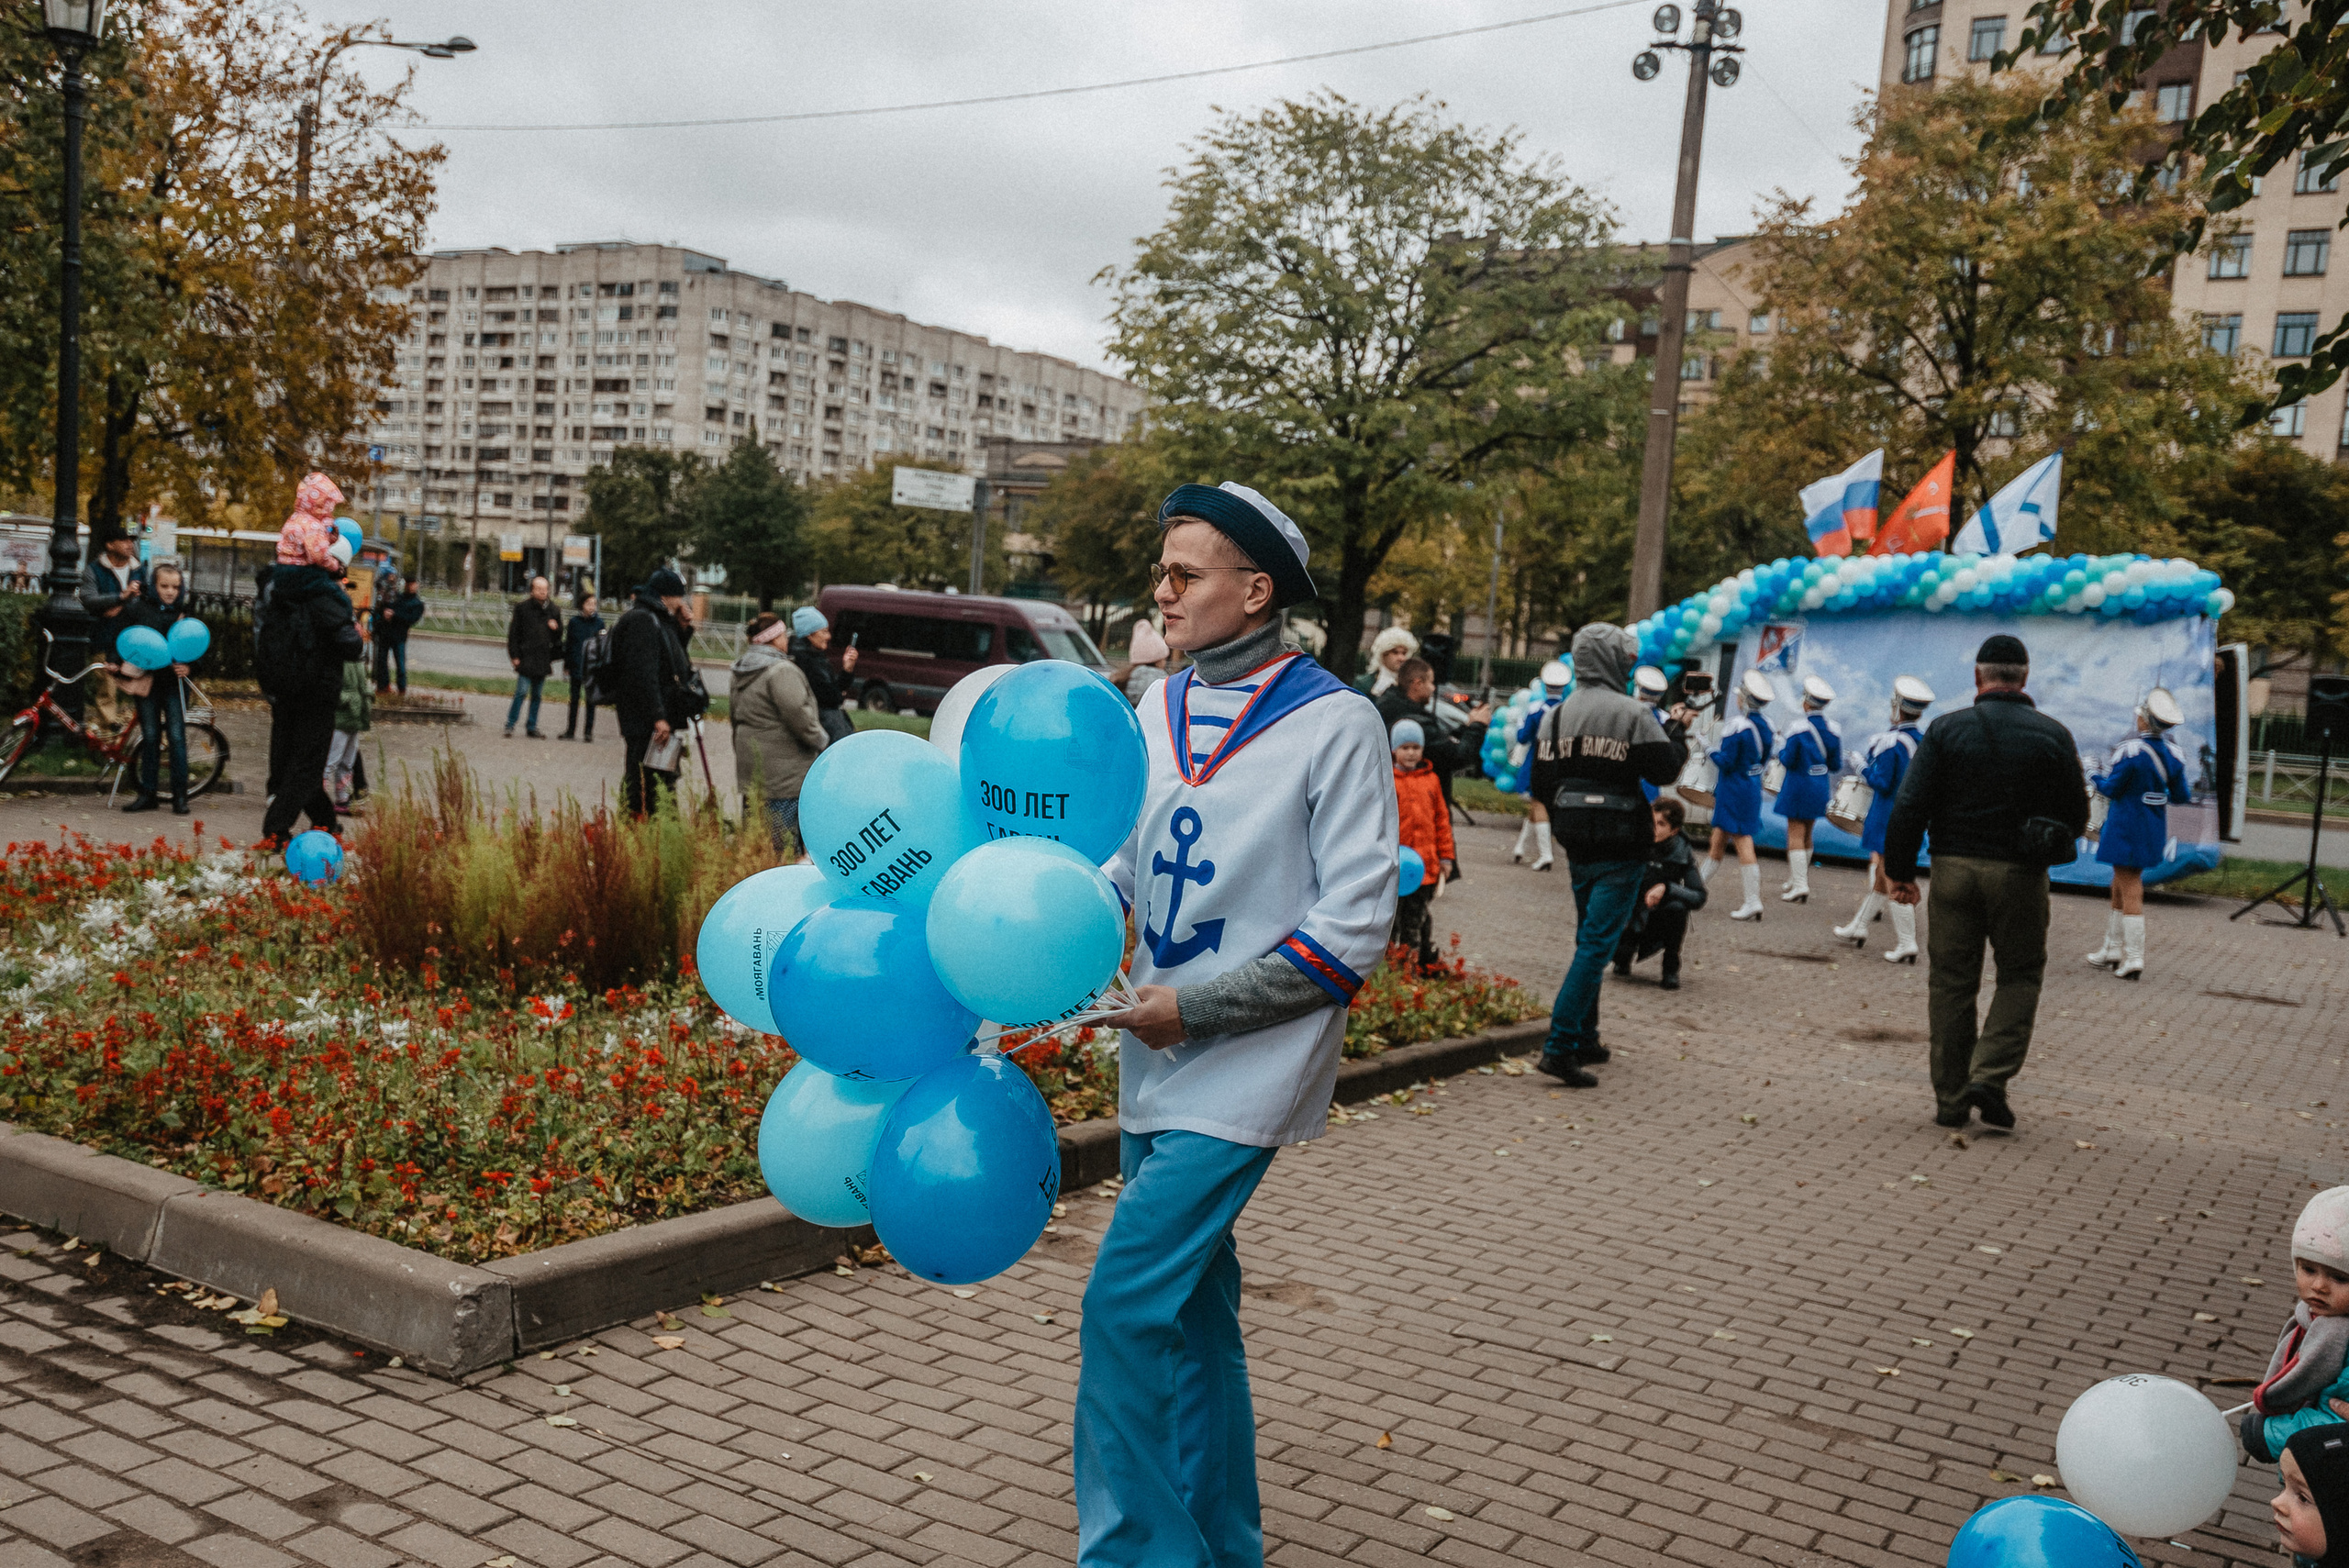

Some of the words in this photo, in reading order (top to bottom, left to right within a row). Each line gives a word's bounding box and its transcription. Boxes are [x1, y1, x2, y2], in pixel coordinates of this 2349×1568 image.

[1581, 735, 1630, 762] FAMOUS
[980, 780, 1016, 815] 300
[1023, 792, 1070, 819] ЛЕТ
[829, 841, 866, 877] 300
[858, 807, 902, 855] ЛЕТ
[861, 847, 932, 897] ГАВАНЬ
